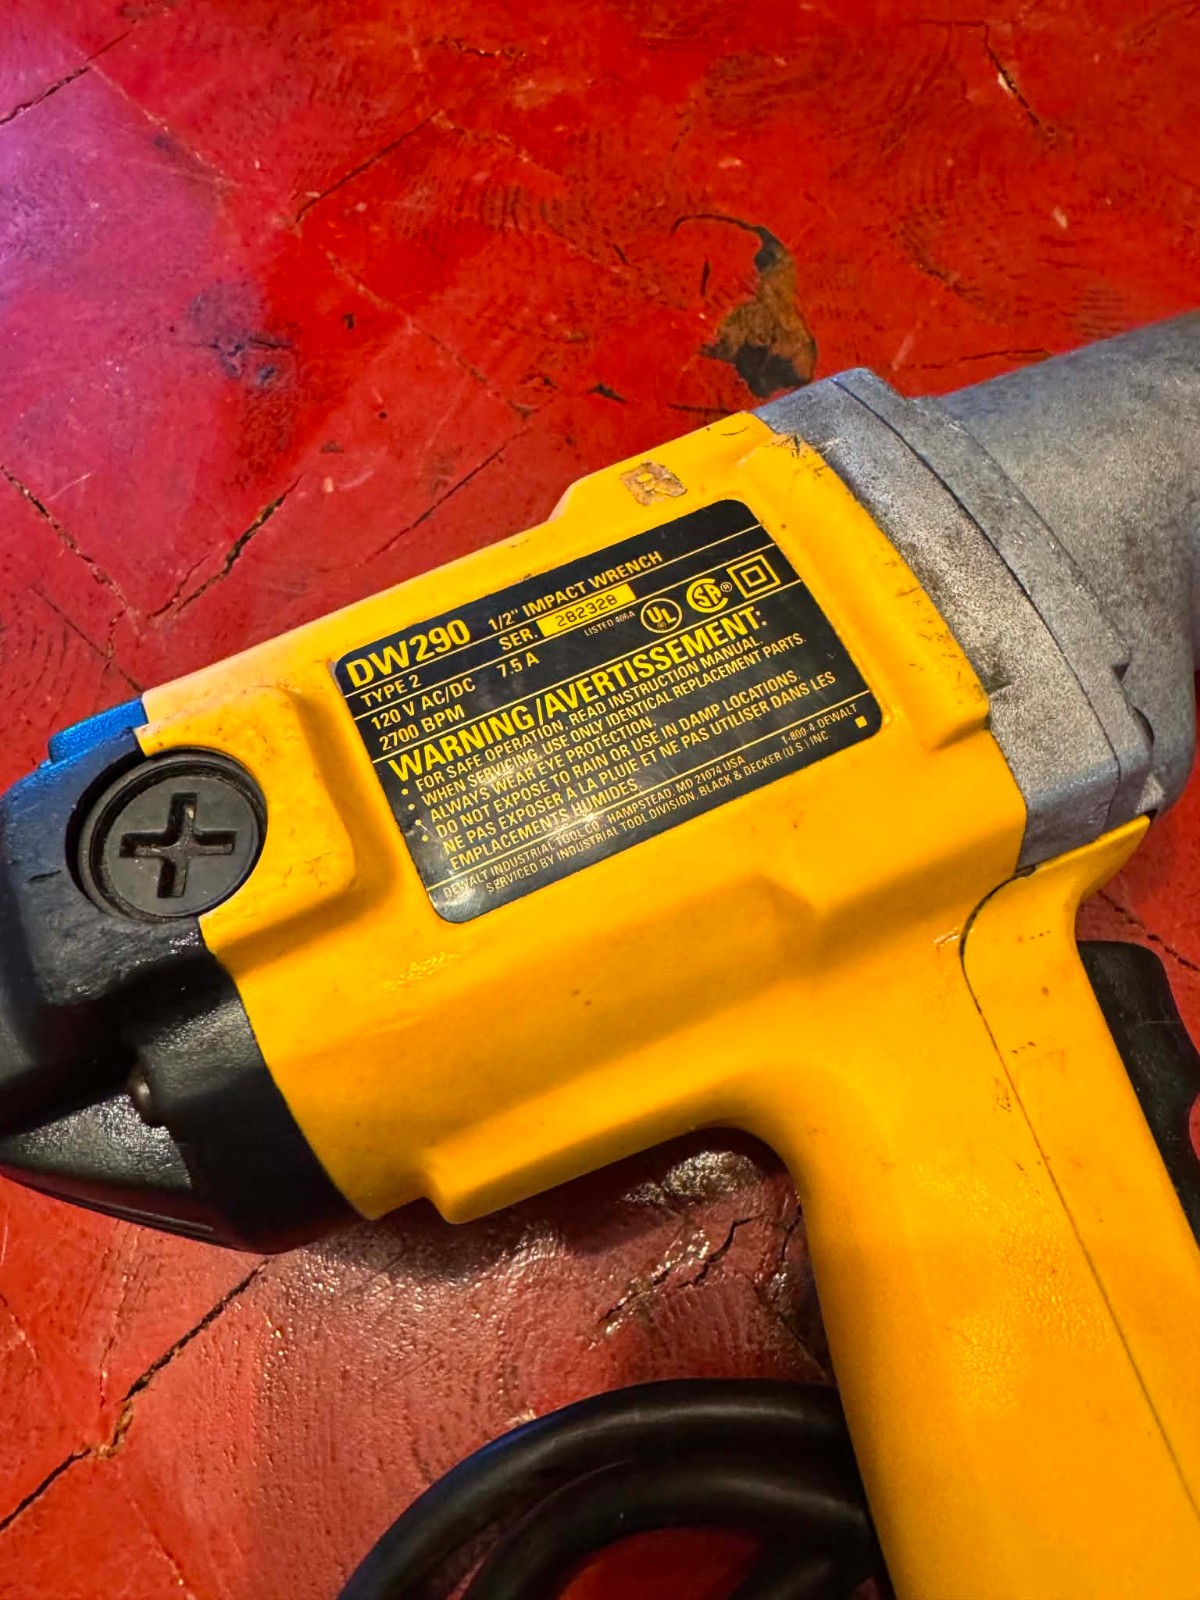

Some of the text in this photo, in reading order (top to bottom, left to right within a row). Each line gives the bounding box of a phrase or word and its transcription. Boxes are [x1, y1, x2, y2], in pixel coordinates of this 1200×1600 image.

[345, 550, 662, 687] DW290 1/2" IMPACT WRENCH
[360, 594, 617, 706] TYPE 2 SER. 282328
[583, 619, 613, 636] LISTED
[371, 651, 539, 729] 120 V AC/DC 7.5 A
[379, 704, 464, 750] 2700 BPM
[415, 635, 762, 791] FOR SAFE OPERATION, READ INSTRUCTION MANUAL.
[421, 778, 466, 806] WHEN
[541, 734, 569, 754] USE
[569, 718, 603, 742] ONLY
[604, 690, 673, 727] IDENTICAL
[671, 649, 761, 698] REPLACEMENT
[761, 632, 806, 658] PARTS.
[816, 703, 856, 728] DEWALT
[430, 715, 656, 822] ALWAYS WEAR EYE PROTECTION.
[435, 819, 458, 839] DO
[459, 803, 489, 827] NOT
[493, 779, 550, 812] EXPOSE
[549, 770, 570, 787] TO
[571, 753, 608, 778] RAIN
[609, 744, 631, 761] OR
[630, 730, 660, 751] USE
[660, 722, 678, 738] IN
[678, 703, 720, 730] DAMP
[442, 671, 835, 855] NE PAS EXPOSER A LA PLUIE ET NE PAS UTILISER DANS LES
[449, 777, 642, 871] EMPLACEMENTS HUMIDES.
[486, 862, 538, 894] SERVICED
[538, 853, 553, 868] BY
[556, 826, 619, 860] INDUSTRIAL
[618, 813, 648, 831] TOOL
[648, 791, 698, 819] DIVISION,
[697, 774, 732, 796] BLACK
[732, 770, 742, 780] &
[742, 751, 782, 775] DECKER
[442, 869, 487, 898] DEWALT
[489, 838, 555, 876] INDUSTRIAL
[554, 828, 585, 846] TOOL
[675, 778, 693, 792] MD
[694, 765, 722, 784] 21074
[722, 755, 745, 770] USA
